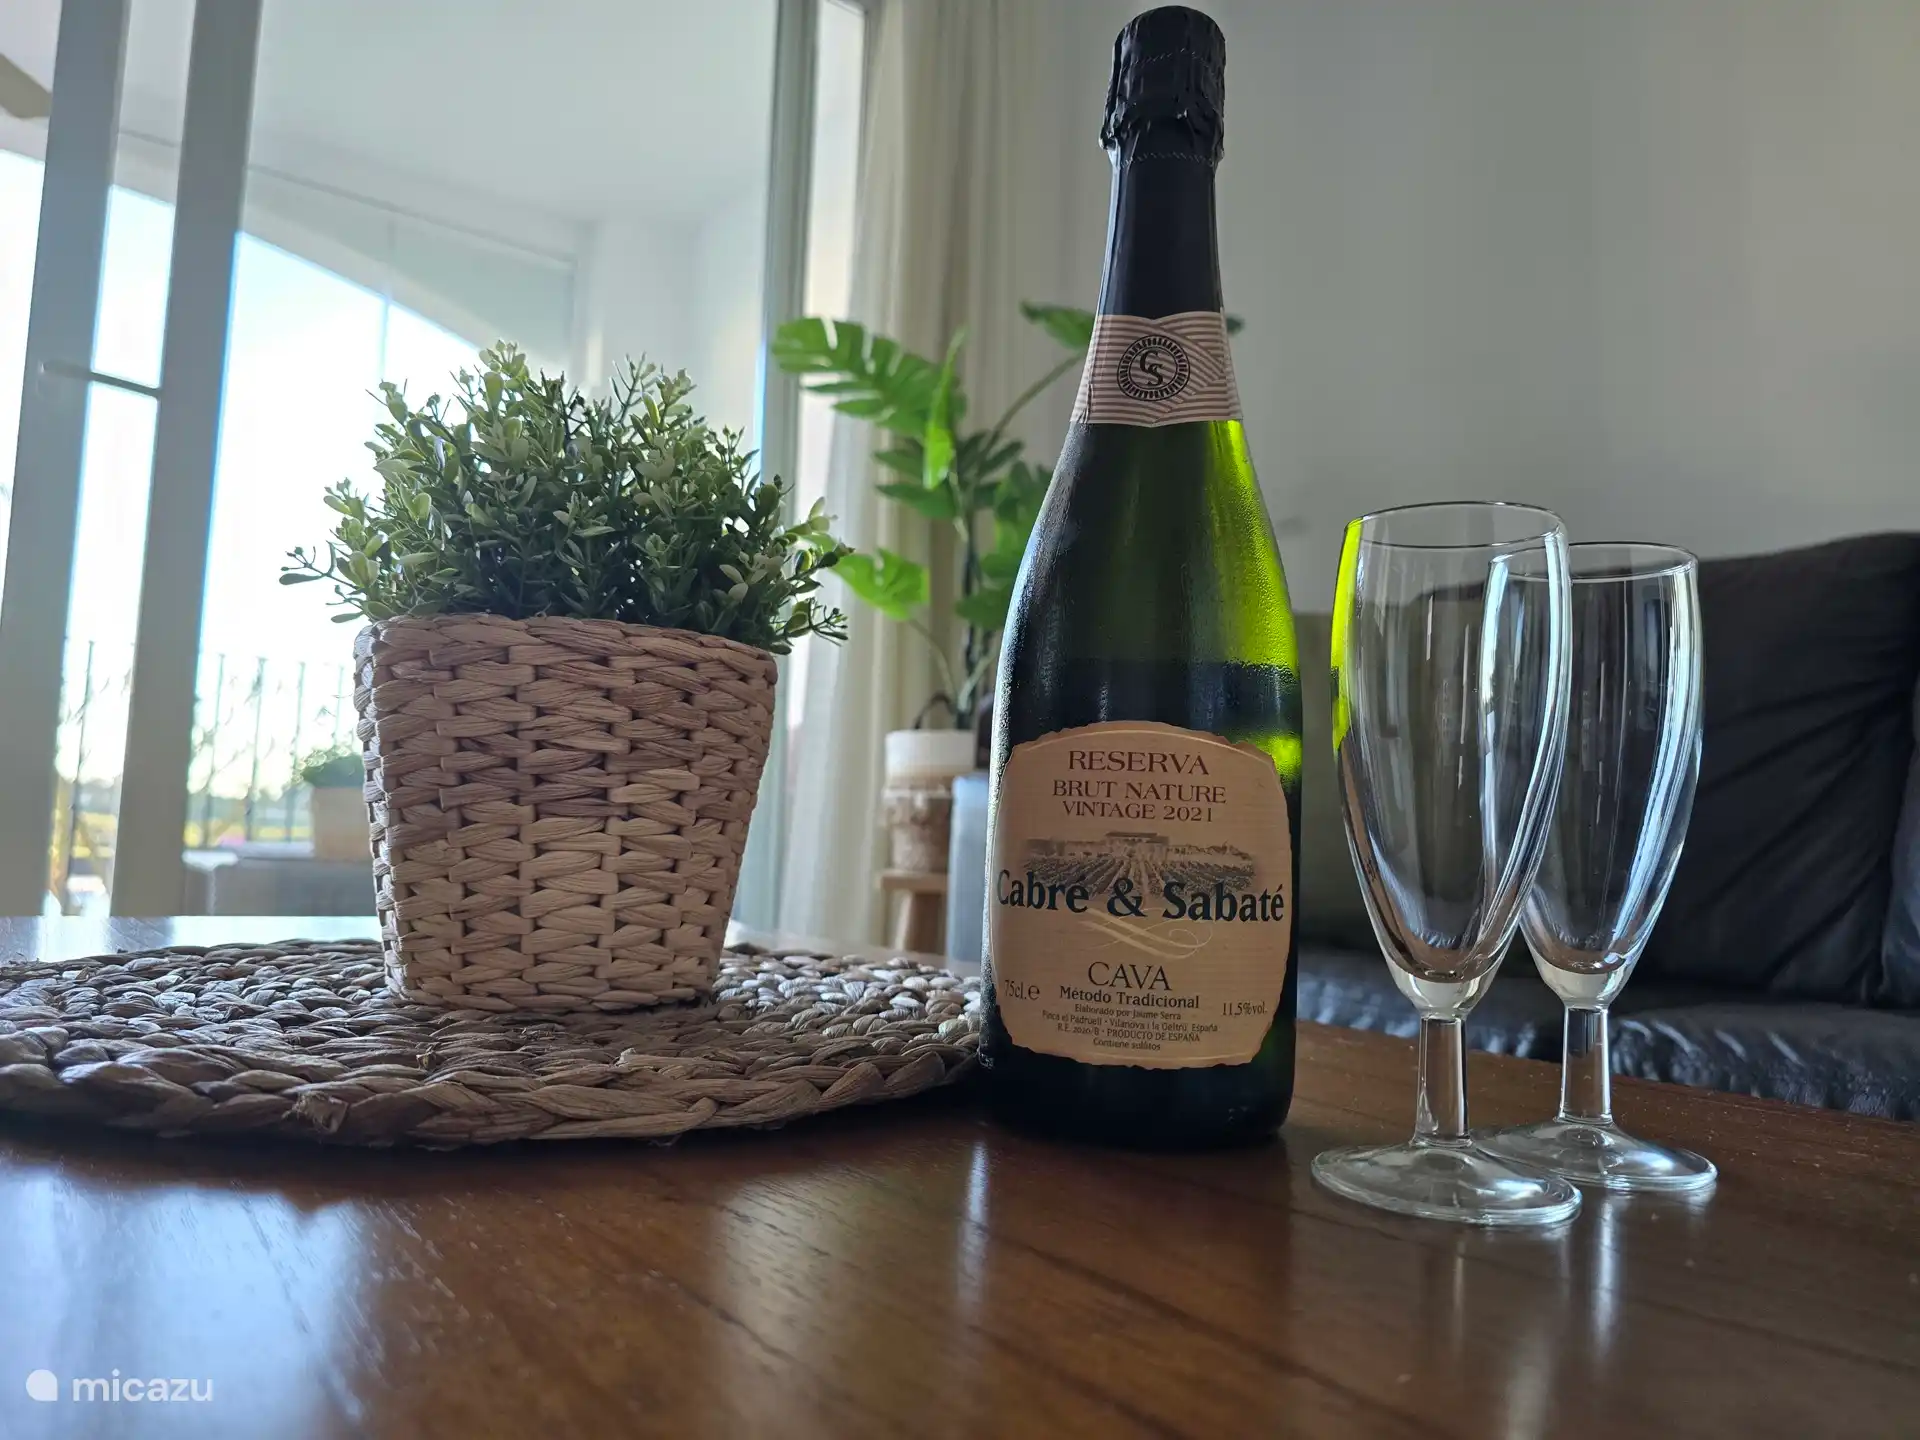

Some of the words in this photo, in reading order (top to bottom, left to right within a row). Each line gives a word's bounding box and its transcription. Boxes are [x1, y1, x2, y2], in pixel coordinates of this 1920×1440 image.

[1068, 750, 1210, 775] RESERVA
[1053, 779, 1117, 798] BRUT
[1125, 782, 1227, 804] NATURE
[1063, 800, 1156, 820] VINTAGE
[1163, 805, 1214, 822] 2021
[997, 869, 1090, 913] Cabré
[1106, 877, 1147, 917] &
[1162, 880, 1285, 922] Sabaté
[1088, 961, 1173, 991] CAVA
[1060, 985, 1112, 1004] Método
[1116, 991, 1200, 1009] Tradicional
[1075, 1004, 1114, 1015] Elaborado
[1116, 1010, 1130, 1018] por
[1160, 1011, 1181, 1020] Serra
[1109, 1018, 1145, 1029] Vilanova
[1107, 1028, 1154, 1040] PRODUCTO
[1155, 1032, 1166, 1041] DE
[1168, 1031, 1200, 1042] ESPAÑA
